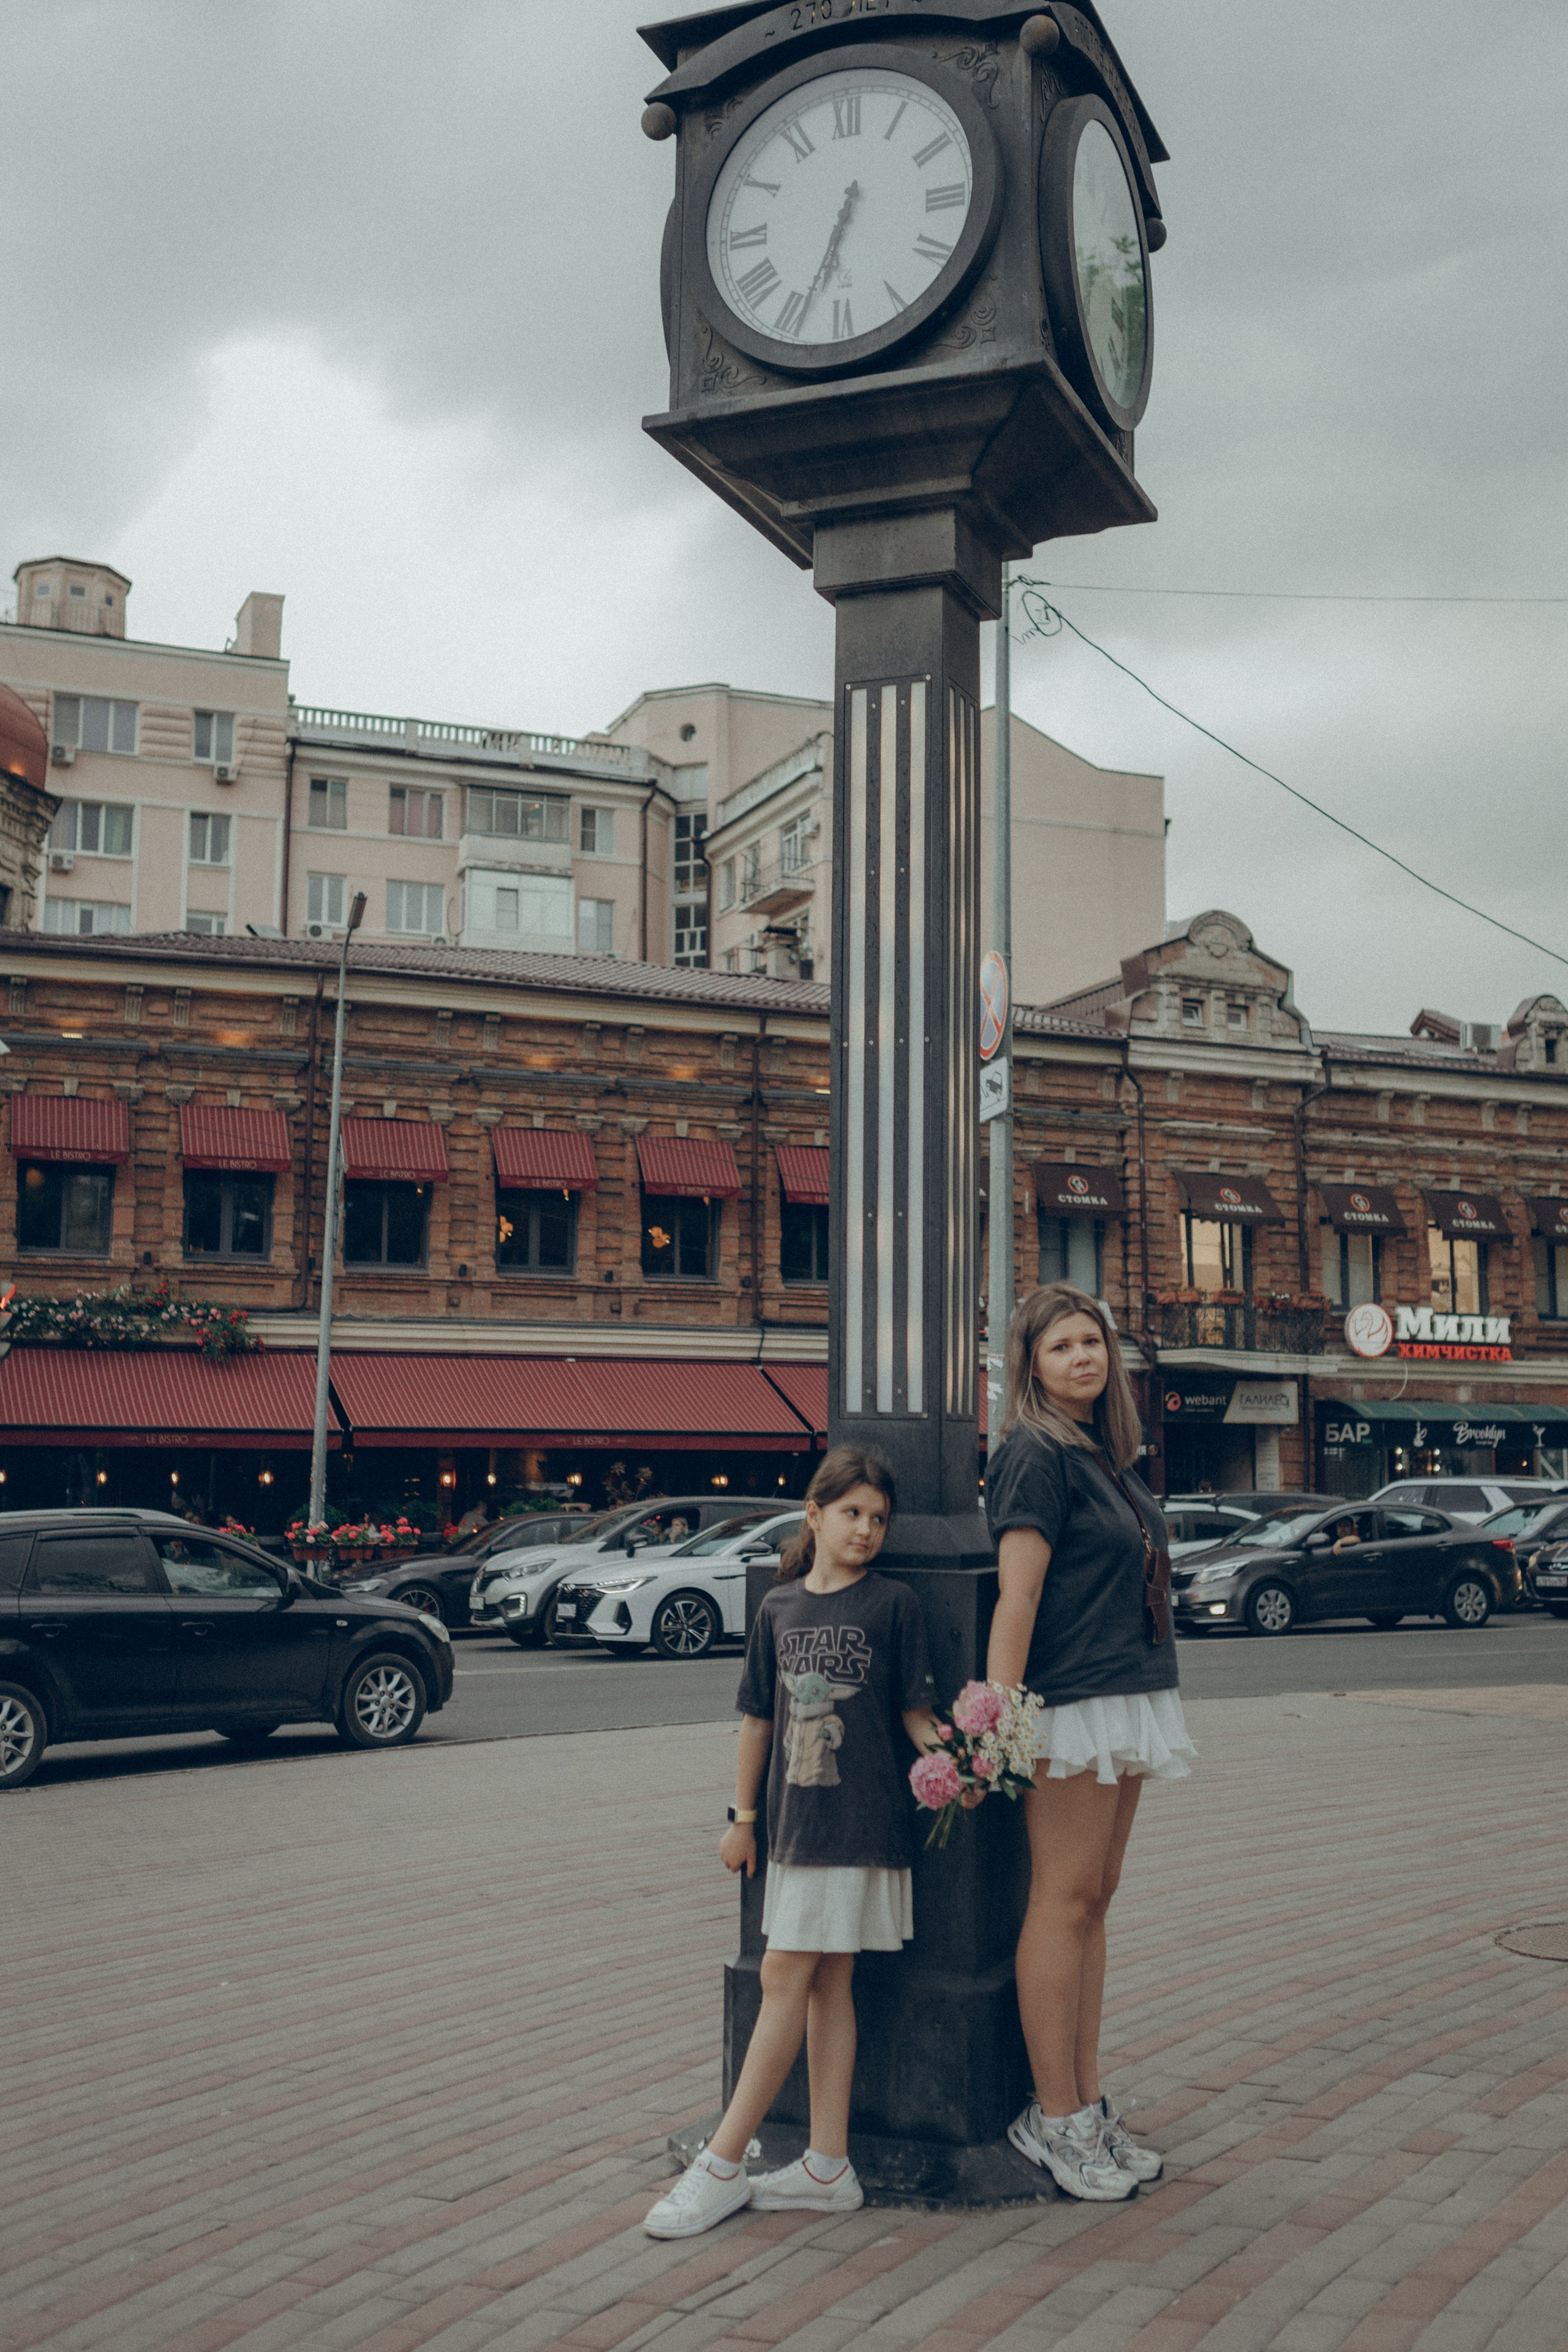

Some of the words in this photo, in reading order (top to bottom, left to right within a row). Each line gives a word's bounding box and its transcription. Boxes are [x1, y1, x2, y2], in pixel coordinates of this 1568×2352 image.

[790, 0, 832, 30] 270
[832, 96, 861, 140] XII
[884, 100, 908, 140] I
[779, 120, 816, 164] XI
[913, 131, 953, 167] II
[742, 174, 781, 198] X
[925, 182, 965, 213] III
[729, 222, 767, 251] IX
[911, 233, 954, 268] IV
[736, 257, 782, 311] VIII
[832, 298, 854, 339] VI
[50, 1150, 61, 1159] LE
[62, 1150, 91, 1161] BISTRO
[219, 1159, 228, 1169] LE
[230, 1160, 256, 1169] BISTRO
[380, 1170, 388, 1178] LE
[1397, 1342, 1513, 1362] ХИМЧИСТКА
[1185, 1394, 1227, 1406] webant
[146, 1434, 156, 1444] LE
[159, 1434, 189, 1444] BISTRO
[1325, 1423, 1371, 1442] БАР
[1453, 1421, 1506, 1449] Brooklyn
[779, 1626, 872, 1657] STAR
[777, 1653, 871, 1683] WARS
